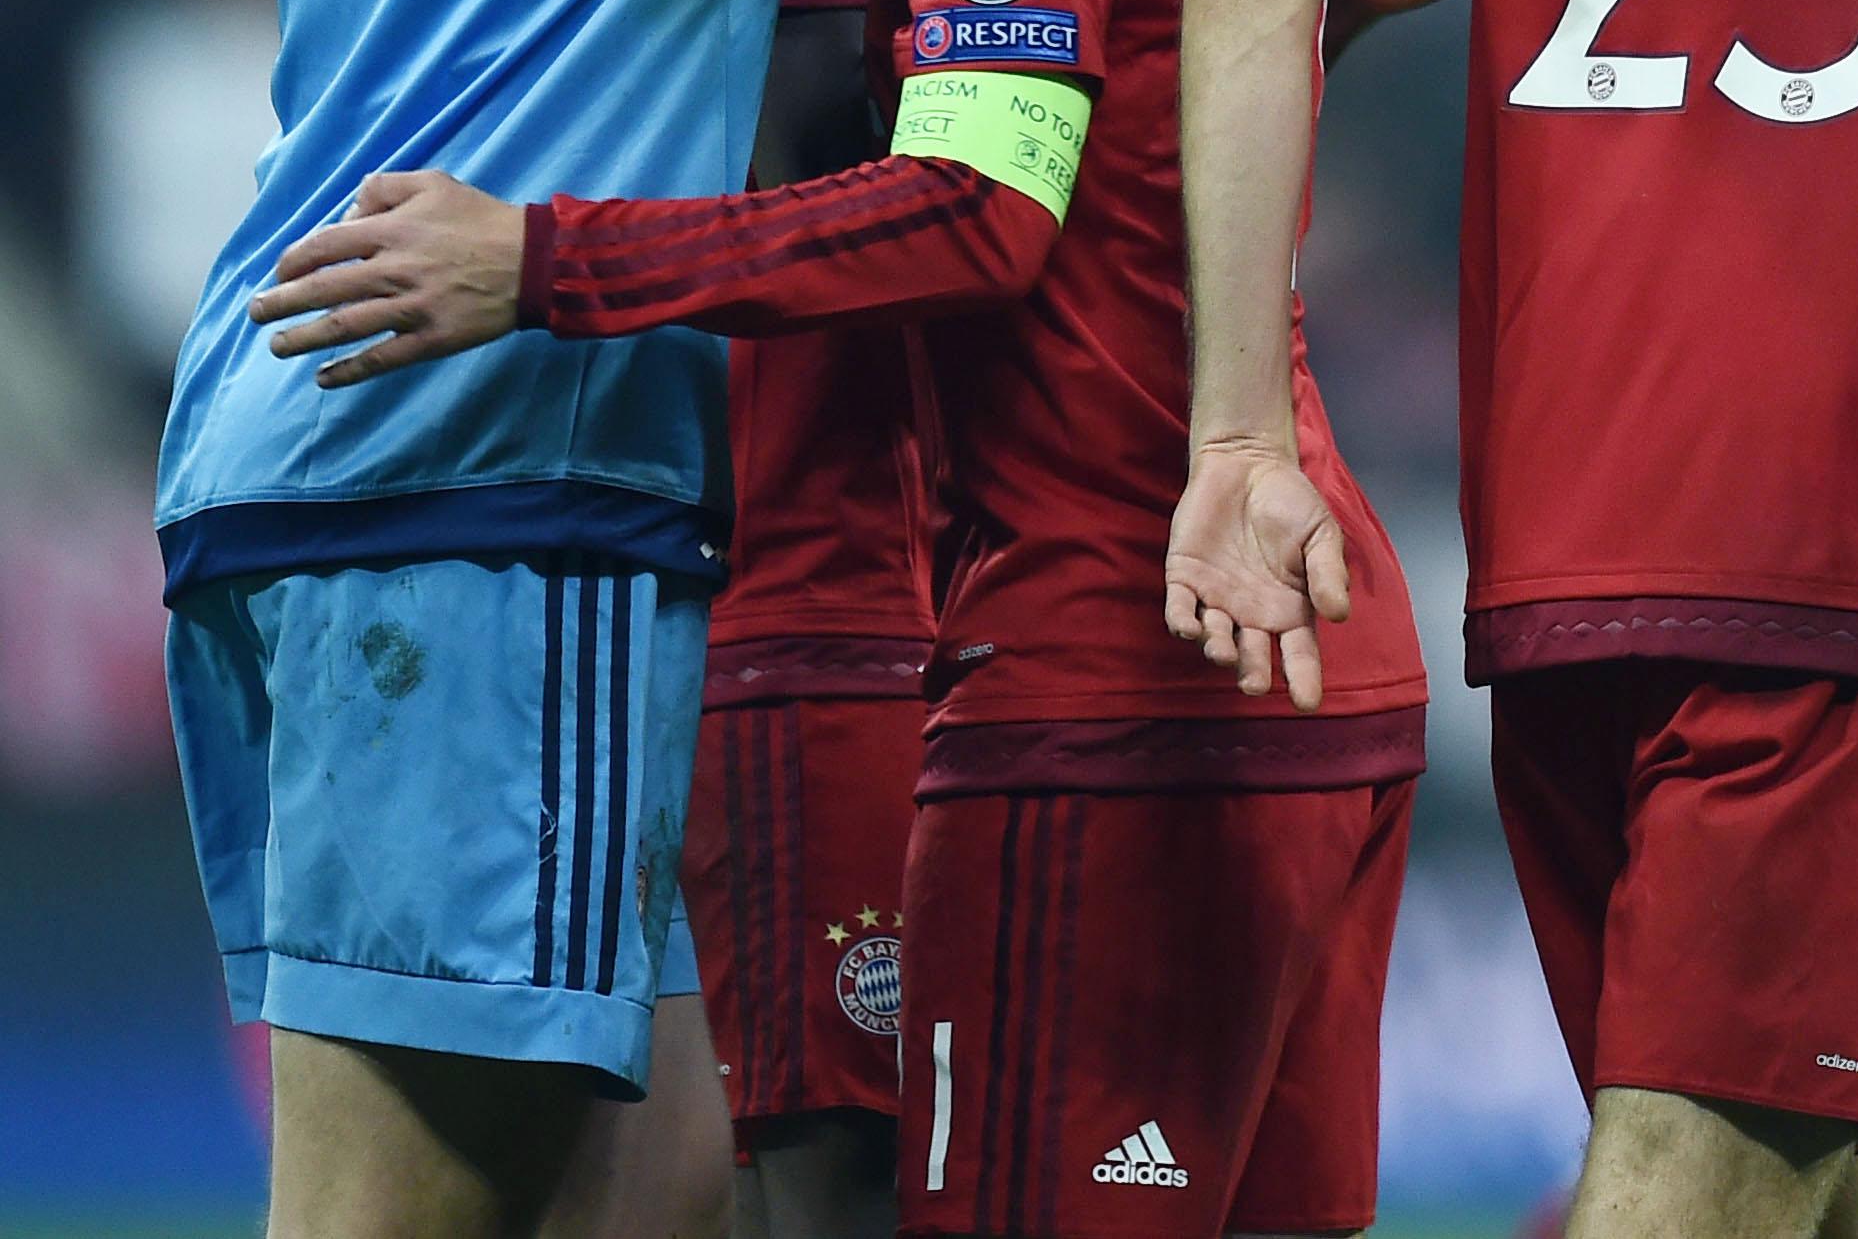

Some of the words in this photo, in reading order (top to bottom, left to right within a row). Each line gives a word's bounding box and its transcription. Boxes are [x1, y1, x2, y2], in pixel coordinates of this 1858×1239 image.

[956, 22, 1077, 49] RESPECT
[1010, 95, 1046, 123] NO
[1052, 113, 1073, 140] TO
[926, 1021, 952, 1191] 1
[1092, 1160, 1189, 1188] adidas
